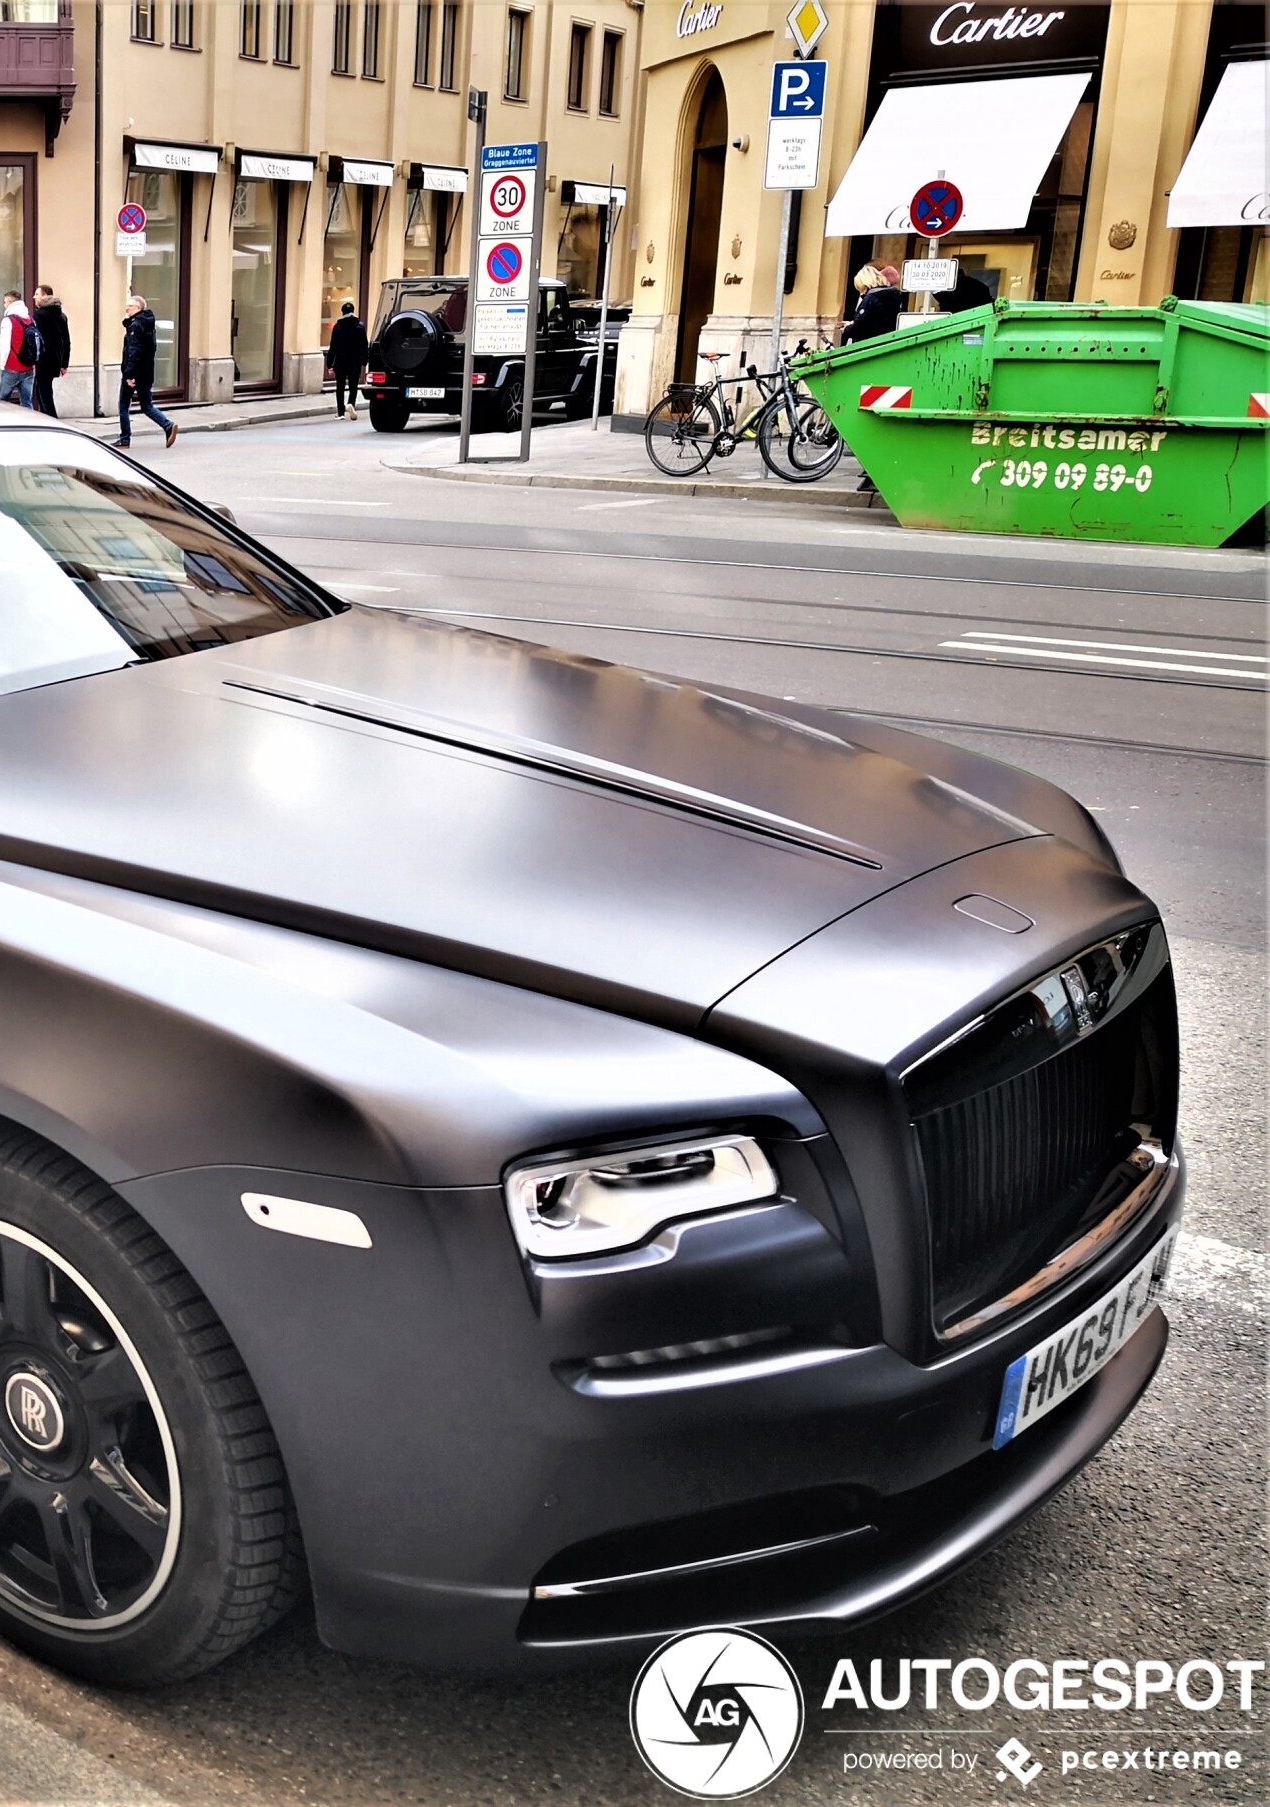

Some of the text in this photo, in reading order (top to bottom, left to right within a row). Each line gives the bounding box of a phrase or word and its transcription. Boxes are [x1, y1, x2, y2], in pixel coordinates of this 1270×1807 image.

[676, 0, 723, 38] Cartier
[930, 1, 1065, 46] Cartier
[779, 68, 810, 111] P
[165, 154, 191, 166] CELINE
[488, 147, 532, 158] Blaue Zone
[267, 163, 290, 176] CELINE
[497, 187, 518, 206] 30
[492, 220, 520, 231] ZONE
[1100, 269, 1136, 280] Cartier
[490, 287, 516, 297] ZONE
[971, 421, 1168, 452] Breitsamer
[1000, 459, 1153, 493] 309 09 89-0
